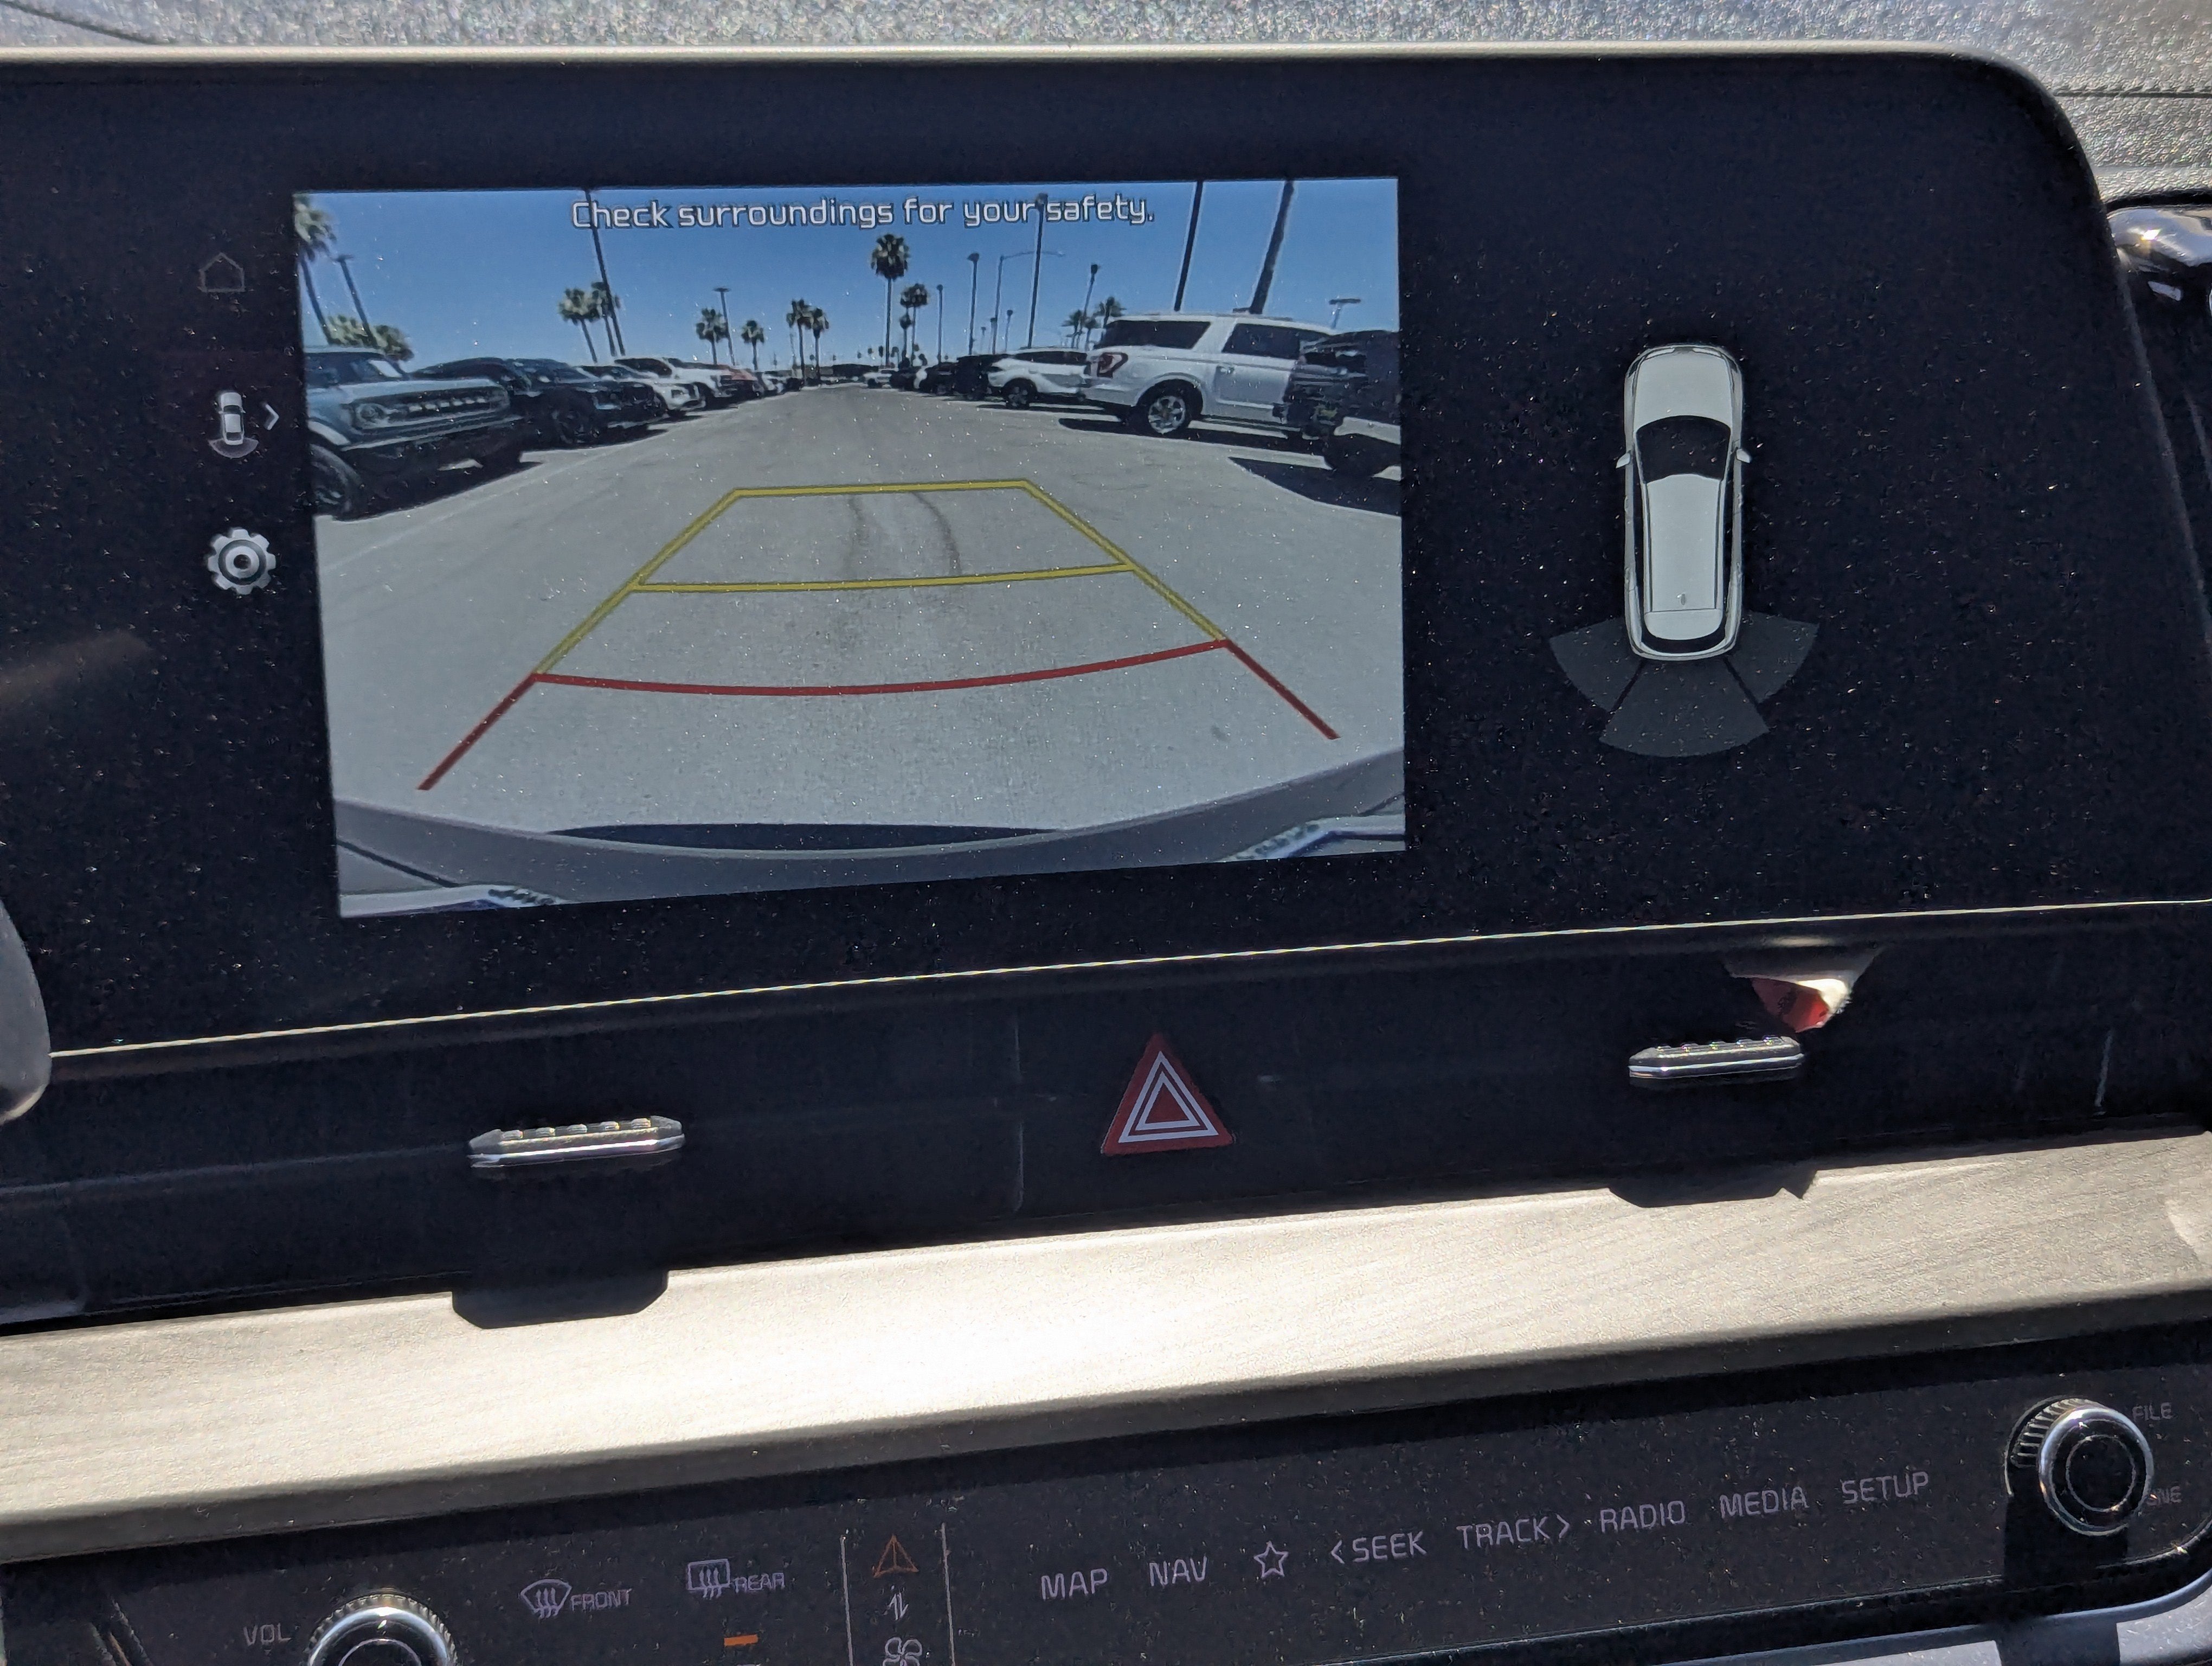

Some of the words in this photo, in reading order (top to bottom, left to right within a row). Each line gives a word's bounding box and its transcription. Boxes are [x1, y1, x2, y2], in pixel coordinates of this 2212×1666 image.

[572, 198, 670, 228] Check
[678, 197, 894, 229] surroundings
[904, 196, 953, 223] for
[964, 200, 1034, 227] your
[1046, 193, 1154, 225] safety.
[2131, 1401, 2174, 1421] FILE
[1719, 1486, 1809, 1518] MEDIA
[1842, 1471, 1930, 1505] SETUP
[1600, 1500, 1687, 1533] RADIO
[1352, 1530, 1427, 1563] SEEK
[1456, 1516, 1551, 1551] TRACK
[734, 1572, 786, 1593] REAR
[1040, 1567, 1108, 1601] MAP
[1148, 1555, 1208, 1587] NAV
[571, 1588, 633, 1612] FRONT
[243, 1624, 292, 1647] VOL
